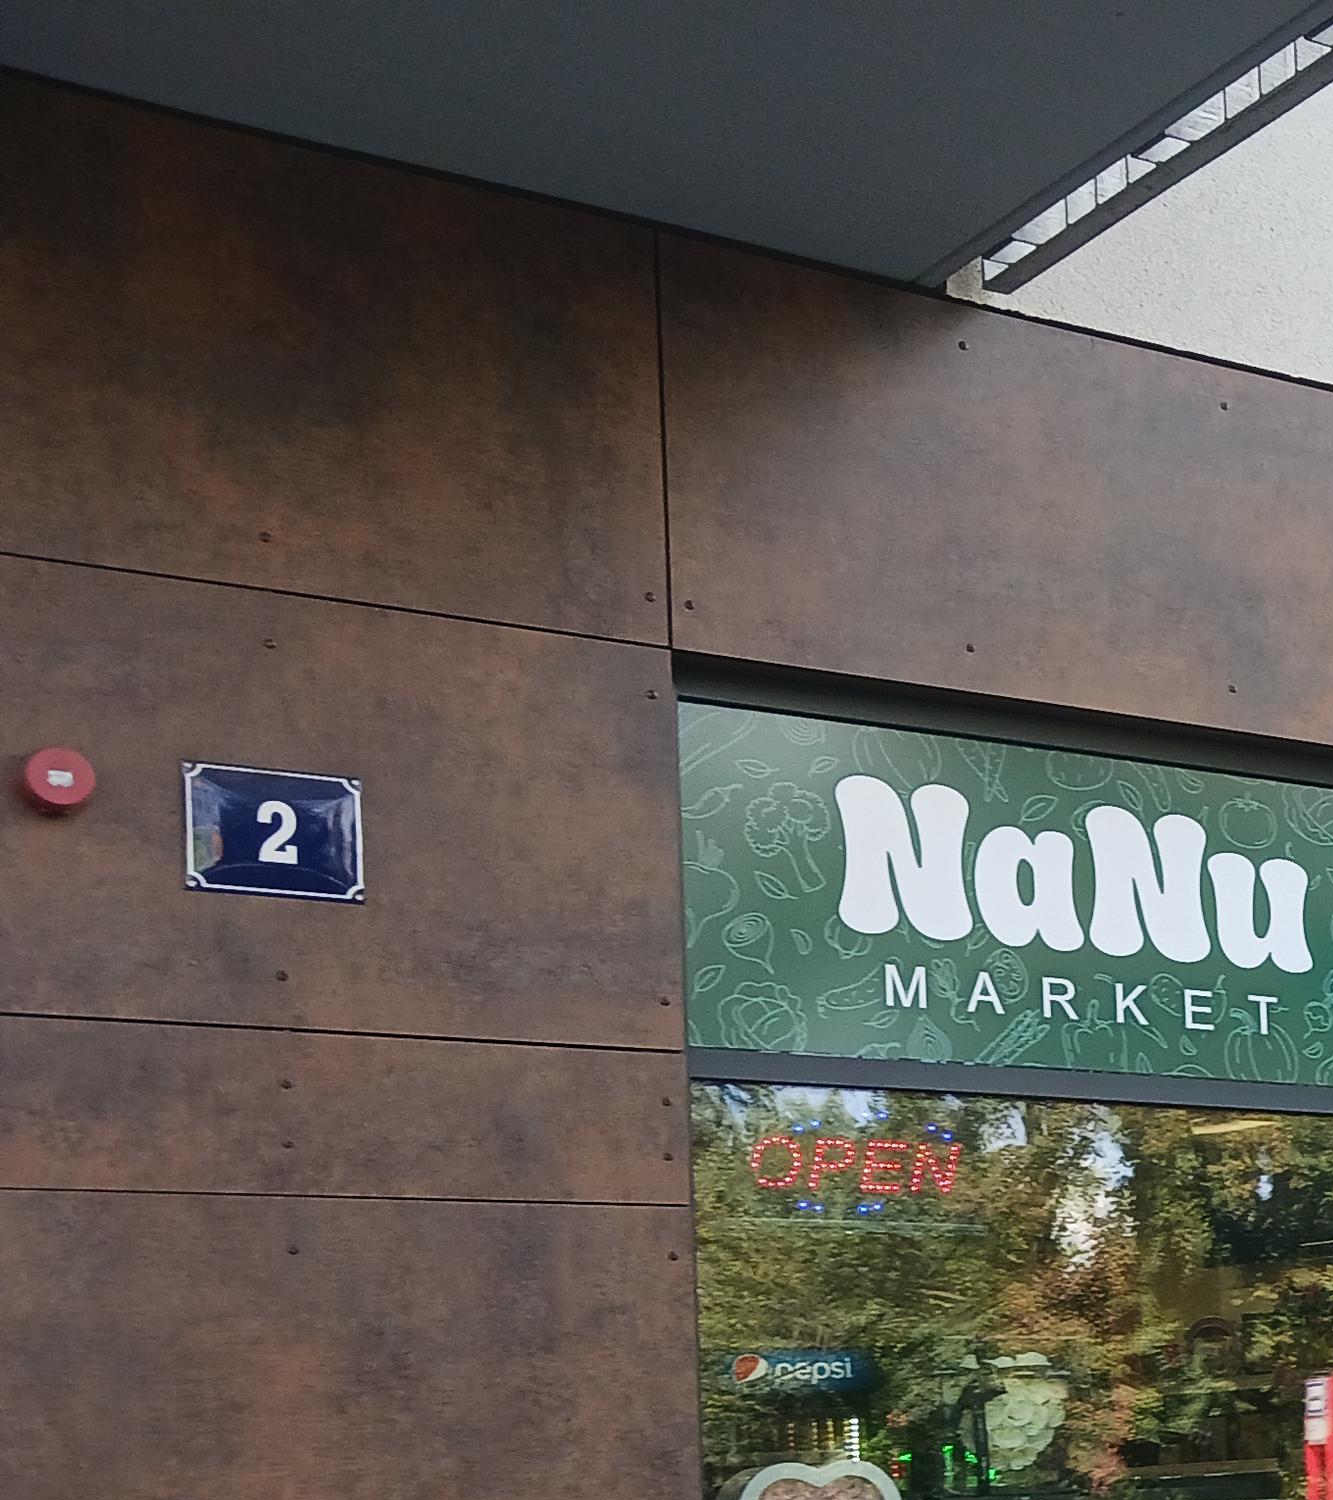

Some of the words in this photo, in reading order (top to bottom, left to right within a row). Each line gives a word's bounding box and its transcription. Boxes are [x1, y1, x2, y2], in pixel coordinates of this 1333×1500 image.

[256, 800, 299, 865] 2
[833, 774, 1314, 974] NaNu
[884, 963, 1279, 1036] MARKET
[750, 1134, 965, 1196] OPEN
[774, 1356, 854, 1387] pepsi
